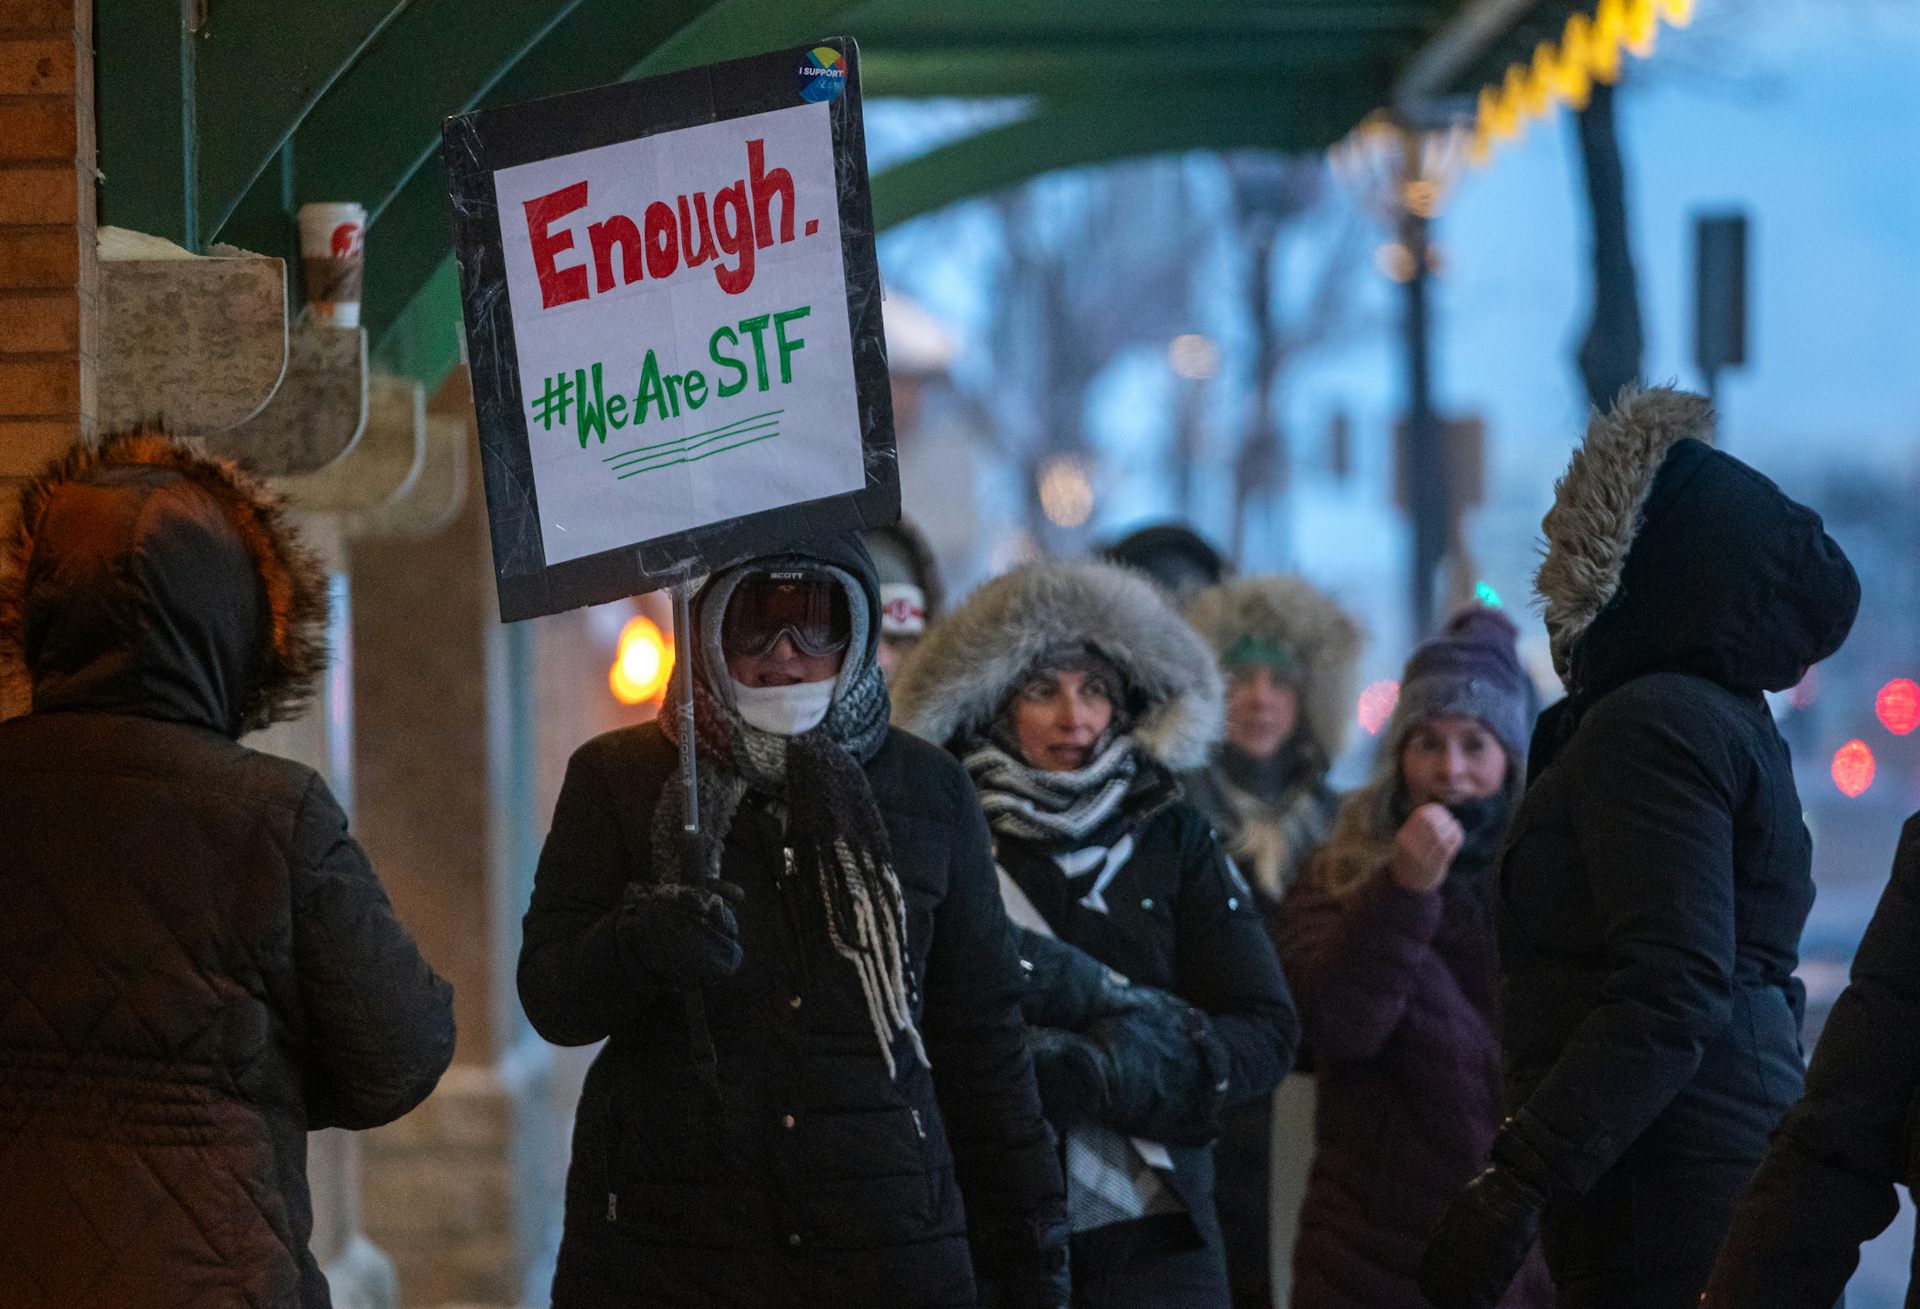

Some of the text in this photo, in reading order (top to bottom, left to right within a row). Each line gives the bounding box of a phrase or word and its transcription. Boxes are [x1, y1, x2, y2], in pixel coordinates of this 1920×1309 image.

[804, 67, 844, 77] SUPPORT
[523, 138, 819, 309] Enough.
[770, 572, 803, 580] SCOTT
